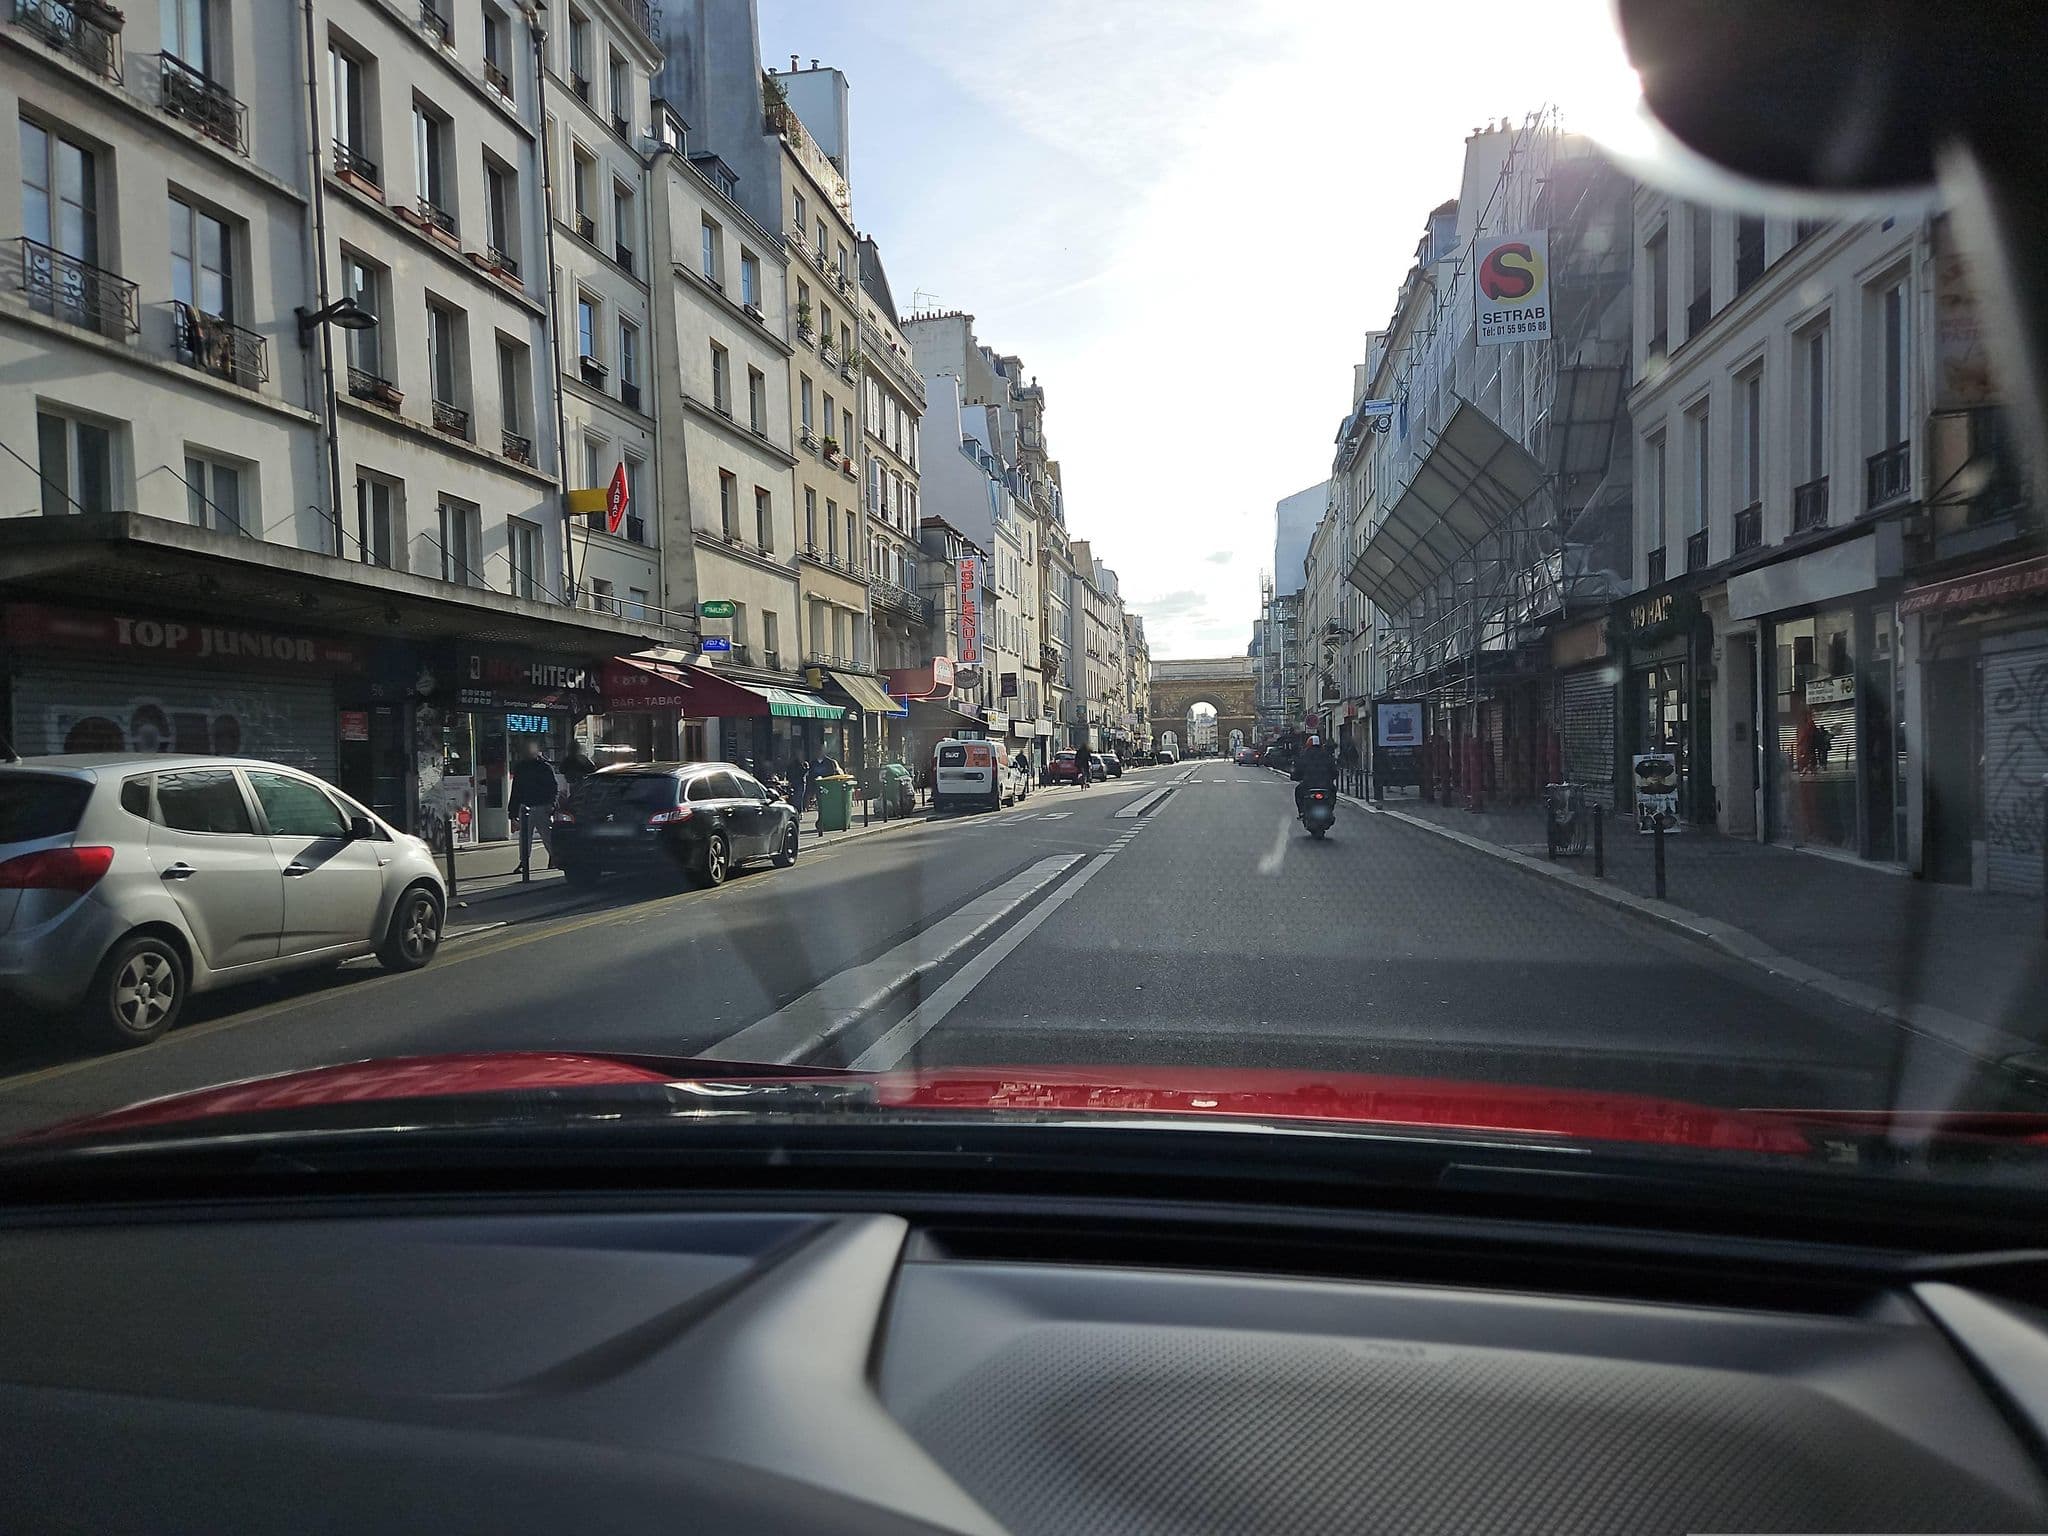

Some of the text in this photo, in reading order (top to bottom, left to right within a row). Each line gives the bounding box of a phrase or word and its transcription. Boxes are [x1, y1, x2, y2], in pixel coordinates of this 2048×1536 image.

[1483, 307, 1545, 325] SETRAB
[1497, 326, 1505, 335] 01
[1508, 325, 1516, 334] 55
[1518, 323, 1526, 333] 95
[1528, 322, 1537, 332] 05
[1538, 321, 1547, 331] 88
[612, 481, 622, 518] TABAC
[114, 617, 190, 650] TOP
[197, 628, 316, 663] JUNIOR
[644, 696, 682, 707] TABAC
